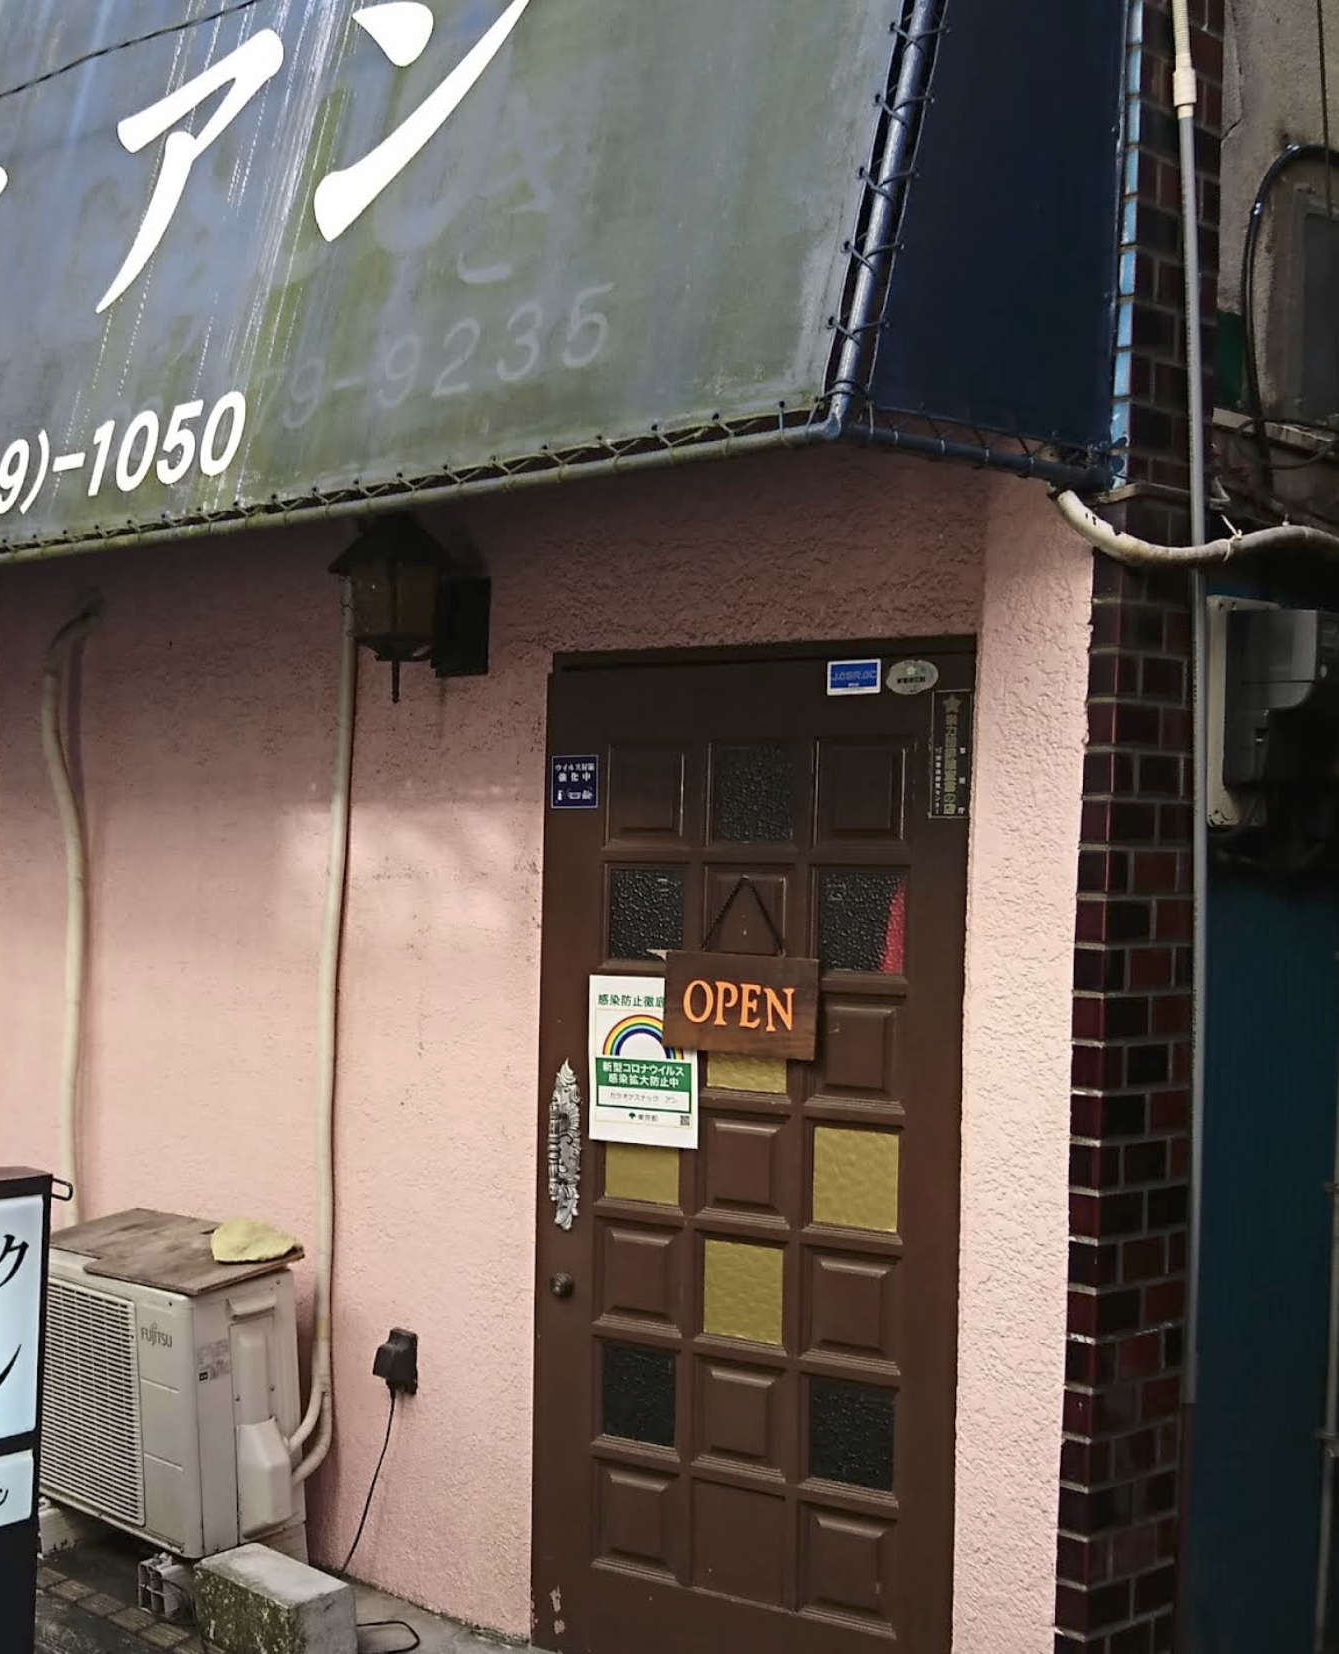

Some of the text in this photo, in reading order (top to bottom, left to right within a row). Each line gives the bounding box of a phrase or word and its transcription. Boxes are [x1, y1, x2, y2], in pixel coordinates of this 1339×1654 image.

[95, 0, 530, 314] アン
[831, 669, 878, 682] JASRAC
[683, 979, 796, 1032] OPEN
[602, 1061, 685, 1077] 新型コロナウイルス
[608, 1073, 679, 1088] 感染拡大防止中
[141, 1322, 173, 1348] FUJITSU
